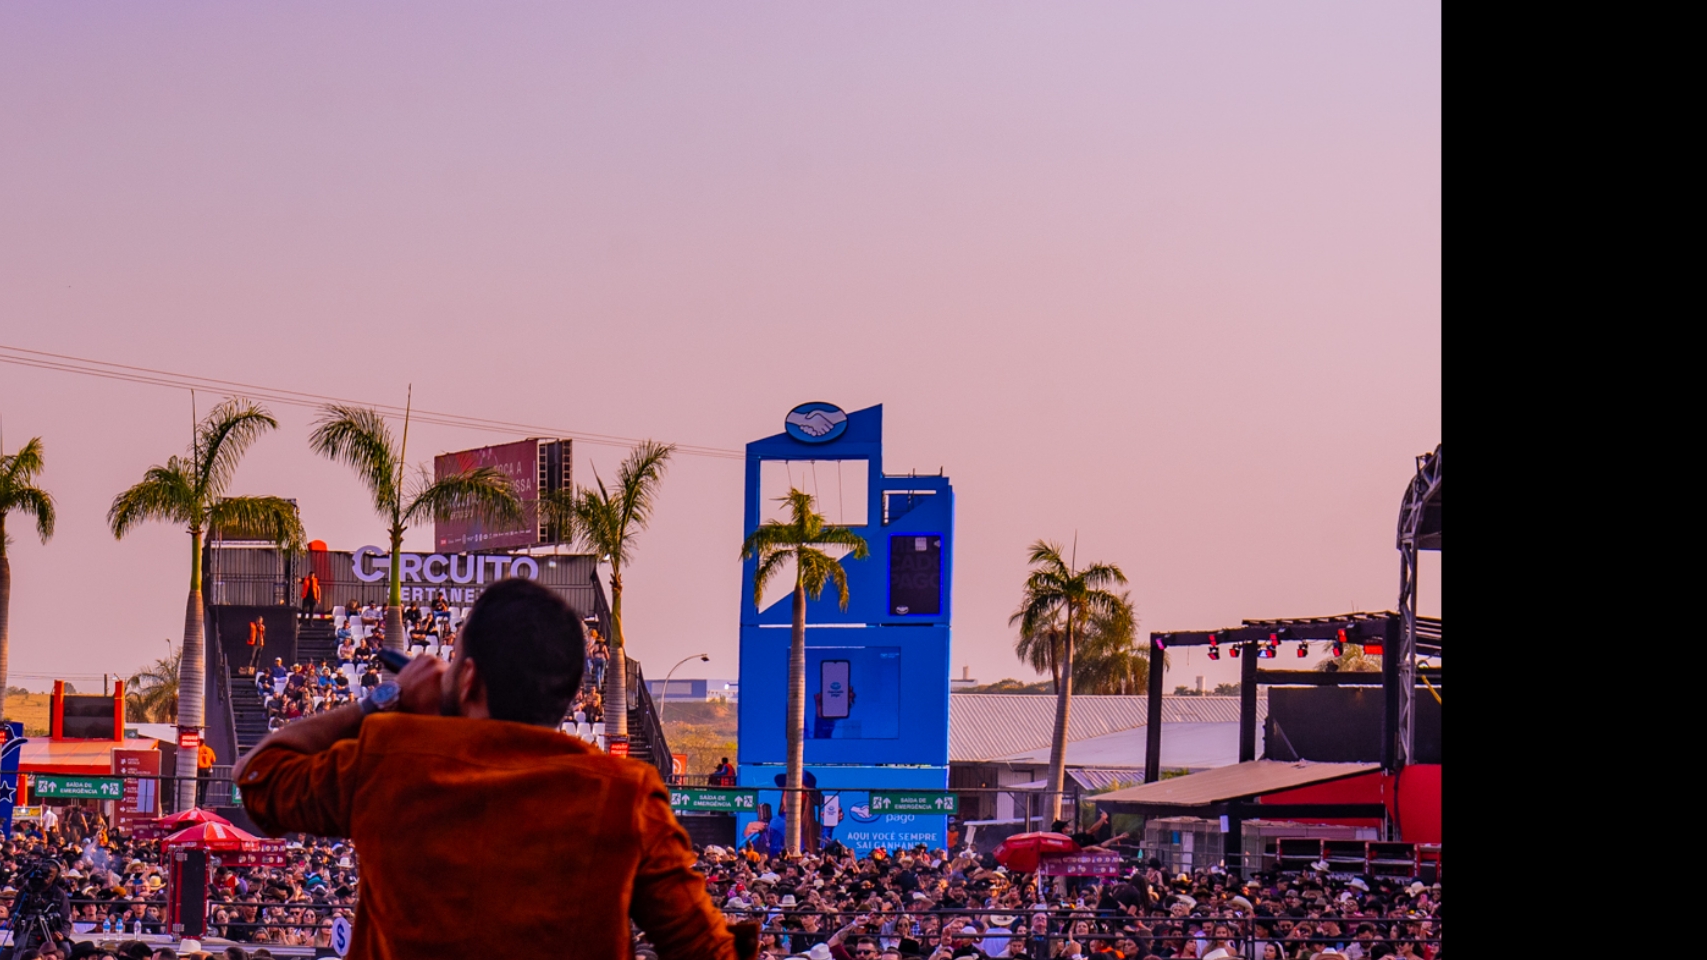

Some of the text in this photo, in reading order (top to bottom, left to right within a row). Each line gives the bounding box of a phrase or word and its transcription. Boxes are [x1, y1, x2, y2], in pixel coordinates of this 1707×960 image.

[352, 545, 539, 584] CRCUITO
[386, 587, 484, 603] ERTANE
[60, 787, 98, 795] EMERGÊNCIA
[885, 814, 916, 824] pago
[847, 831, 937, 842] AQUI VOCÊ SEMPRE
[856, 841, 872, 850] SAI
